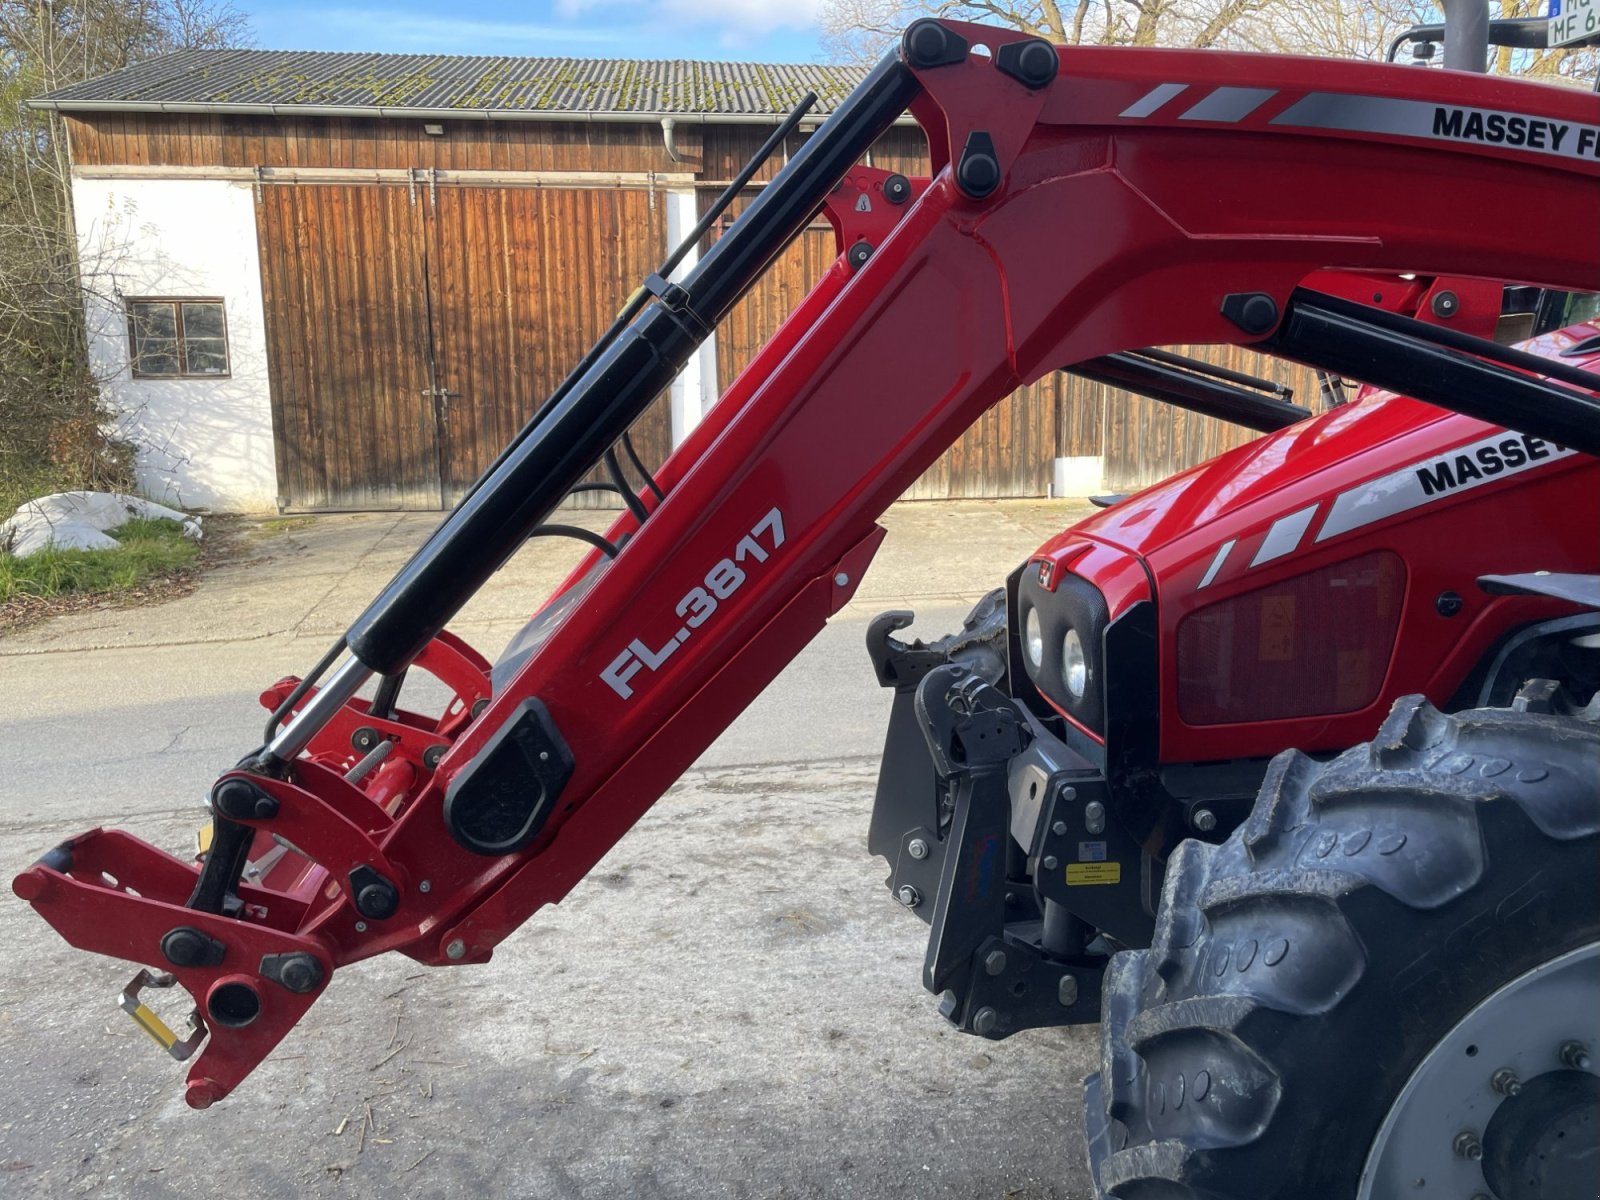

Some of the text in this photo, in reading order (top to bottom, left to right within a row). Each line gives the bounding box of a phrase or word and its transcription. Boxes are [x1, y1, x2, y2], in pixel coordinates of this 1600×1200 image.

[1554, 8, 1600, 44] MF 6
[1432, 107, 1569, 151] MASSEY
[1416, 434, 1567, 496] MASSE
[599, 506, 786, 701] FL.3817
